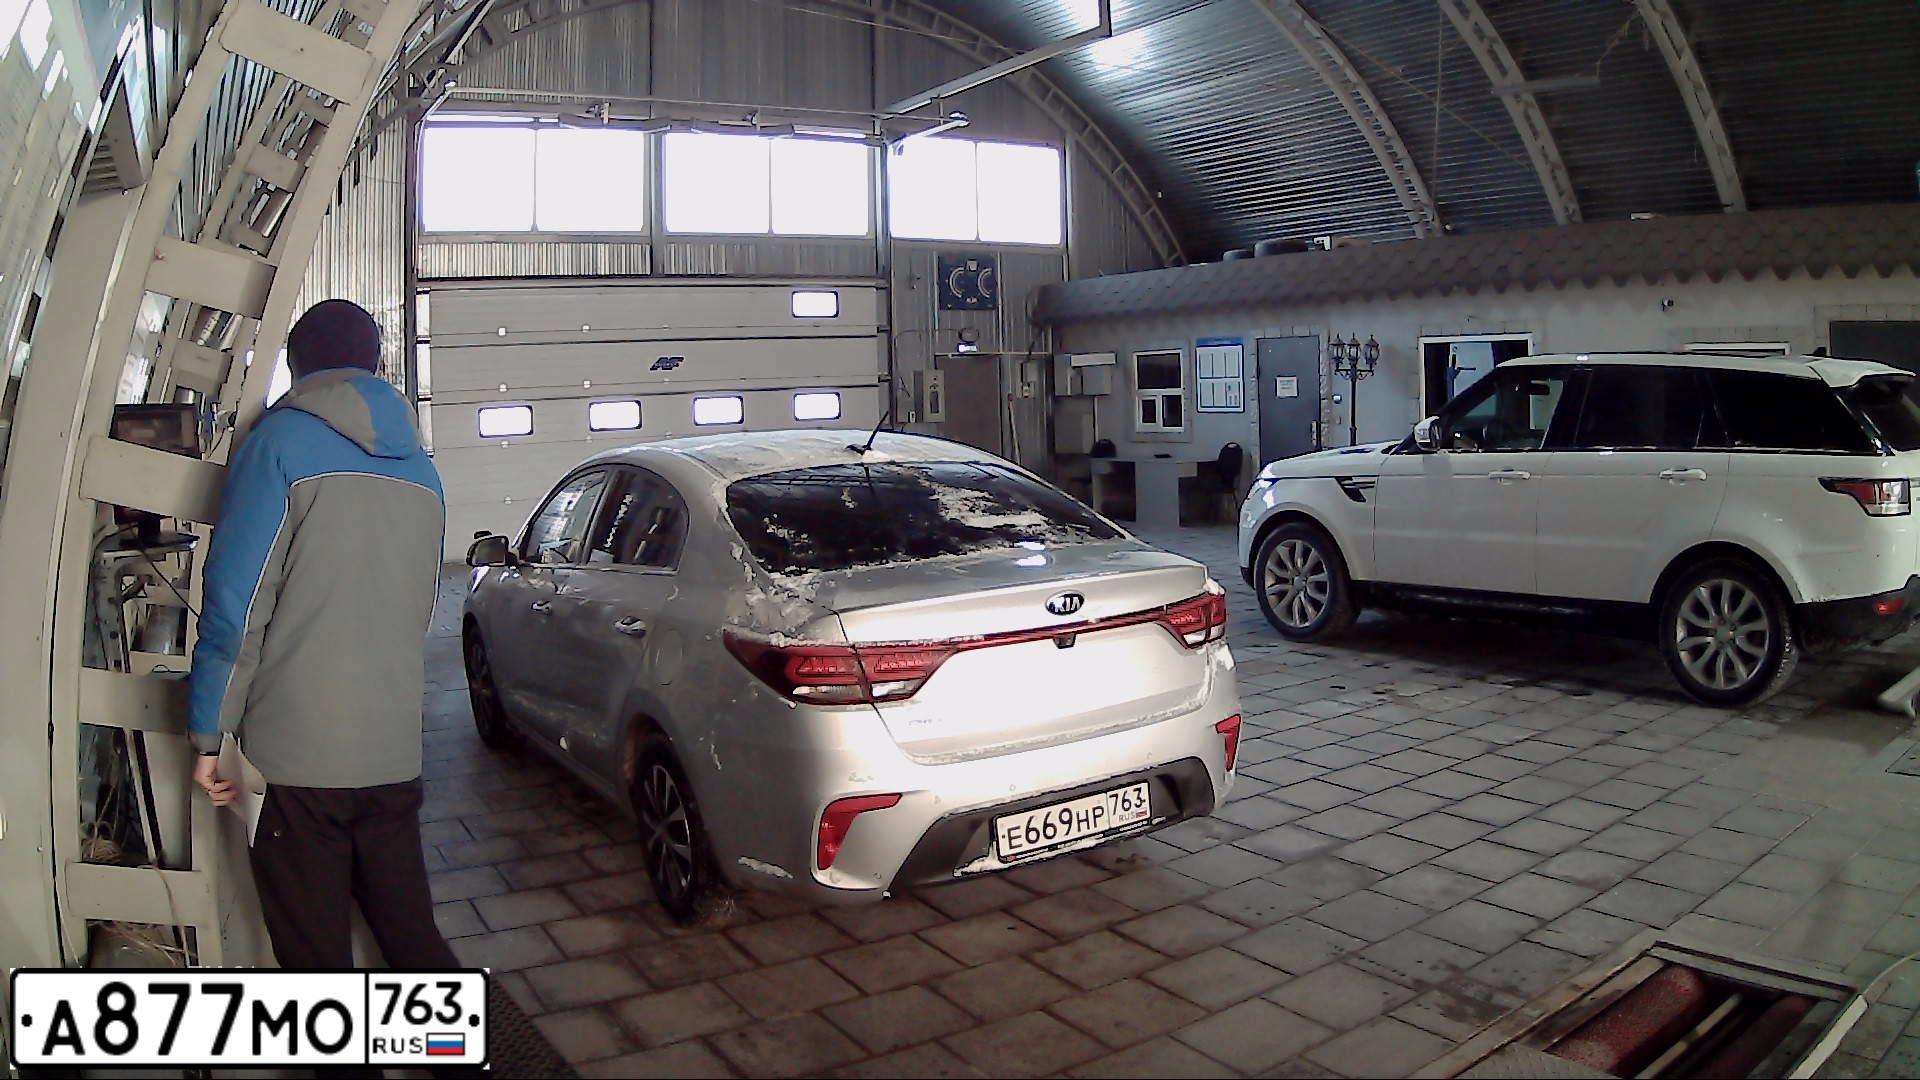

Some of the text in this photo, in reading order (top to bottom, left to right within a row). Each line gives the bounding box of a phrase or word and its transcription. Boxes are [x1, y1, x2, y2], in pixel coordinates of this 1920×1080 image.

[1054, 596, 1080, 613] KIA
[1109, 787, 1145, 816] 763
[1118, 811, 1136, 823] RUS
